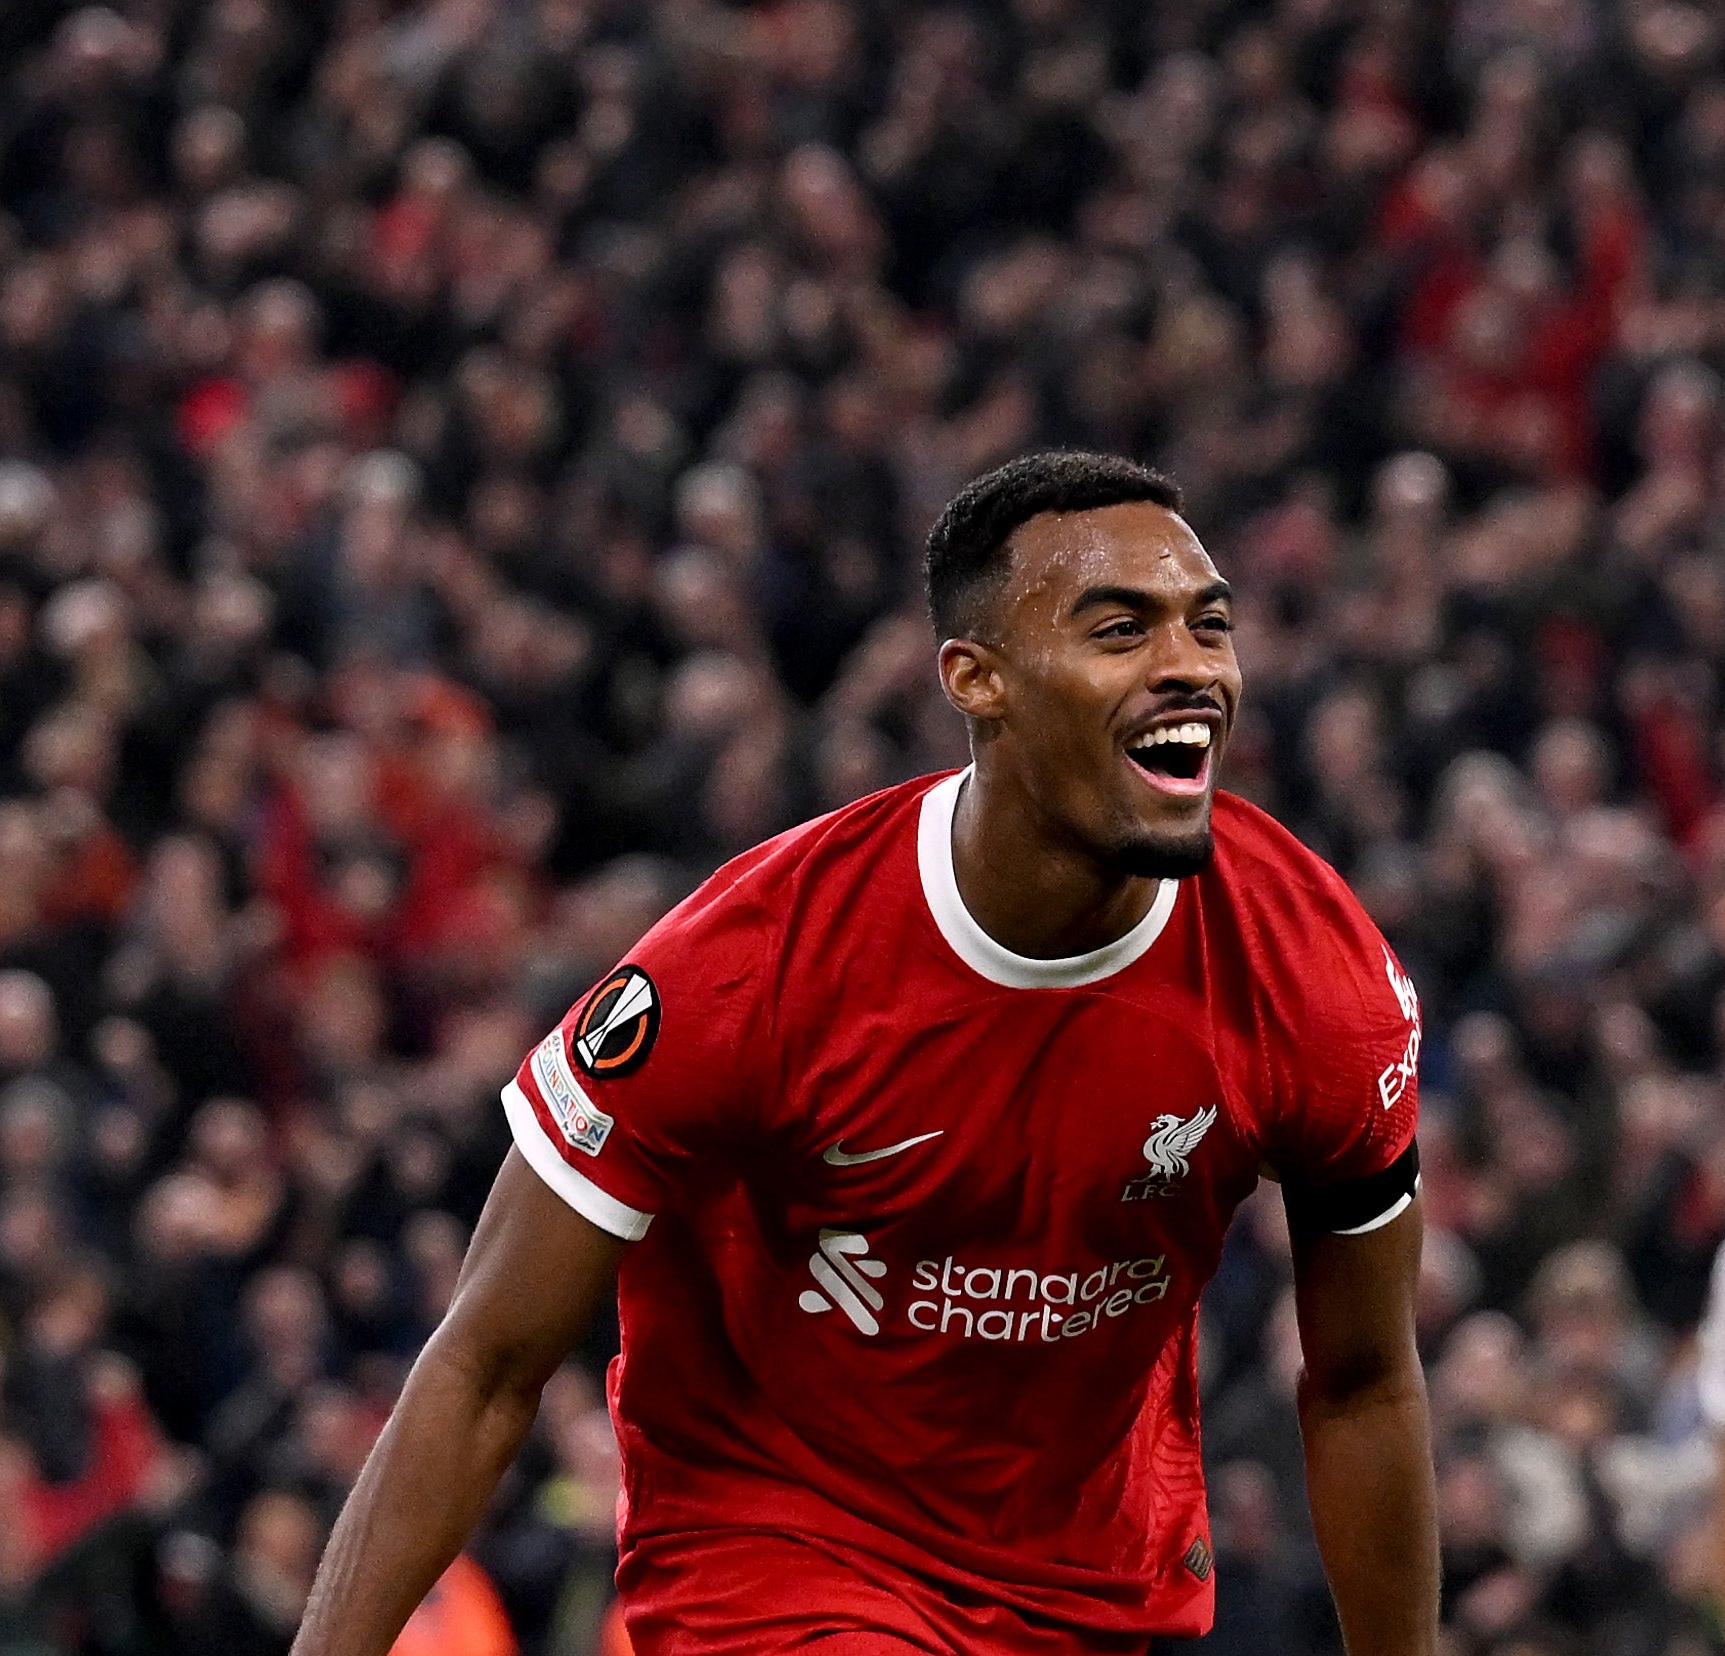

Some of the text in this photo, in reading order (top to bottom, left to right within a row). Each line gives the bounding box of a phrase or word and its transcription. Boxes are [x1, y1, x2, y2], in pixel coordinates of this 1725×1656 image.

[1378, 1021, 1421, 1111] Exp
[907, 1275, 1171, 1343] chartered
[912, 1254, 1166, 1305] standard
